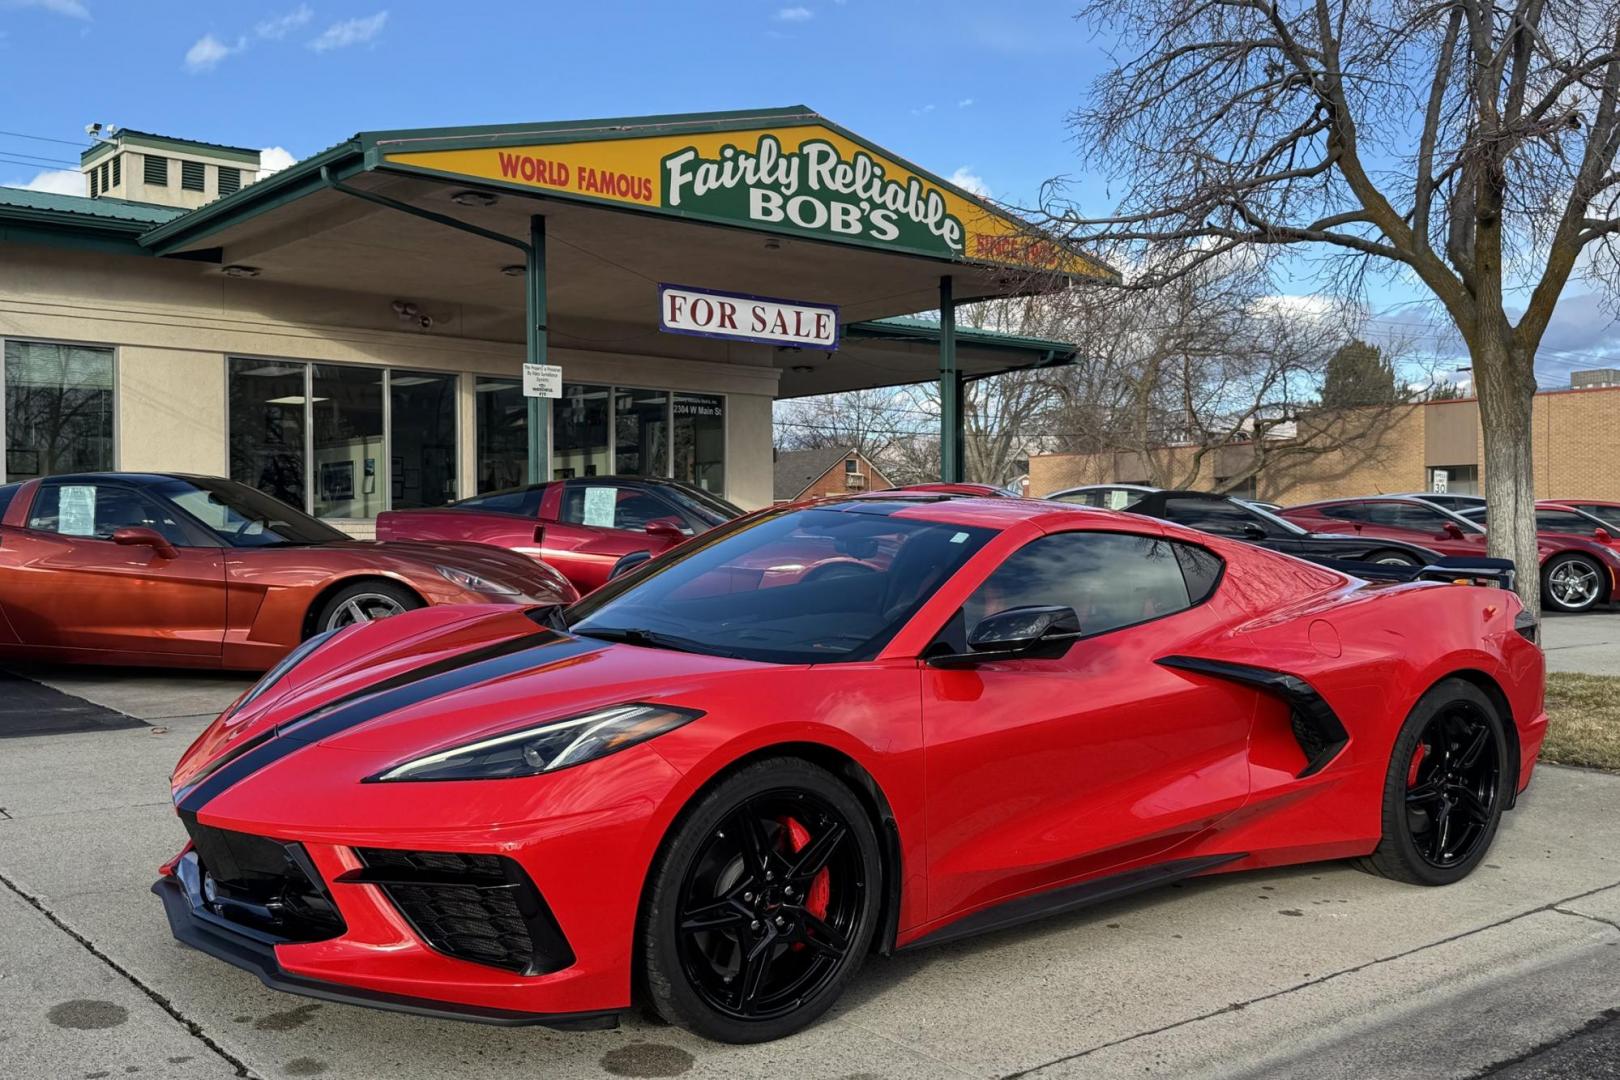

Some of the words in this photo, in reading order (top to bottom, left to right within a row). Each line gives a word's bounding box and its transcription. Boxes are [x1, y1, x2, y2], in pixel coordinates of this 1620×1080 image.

[498, 152, 570, 187] WORLD
[577, 166, 653, 202] FAMOUS
[666, 138, 800, 206] Fairly
[803, 142, 962, 249] Reliable
[750, 187, 899, 241] BOB'S
[667, 294, 738, 330] FOR
[751, 305, 831, 340] SALE
[690, 405, 697, 414] W
[698, 406, 714, 415] Main
